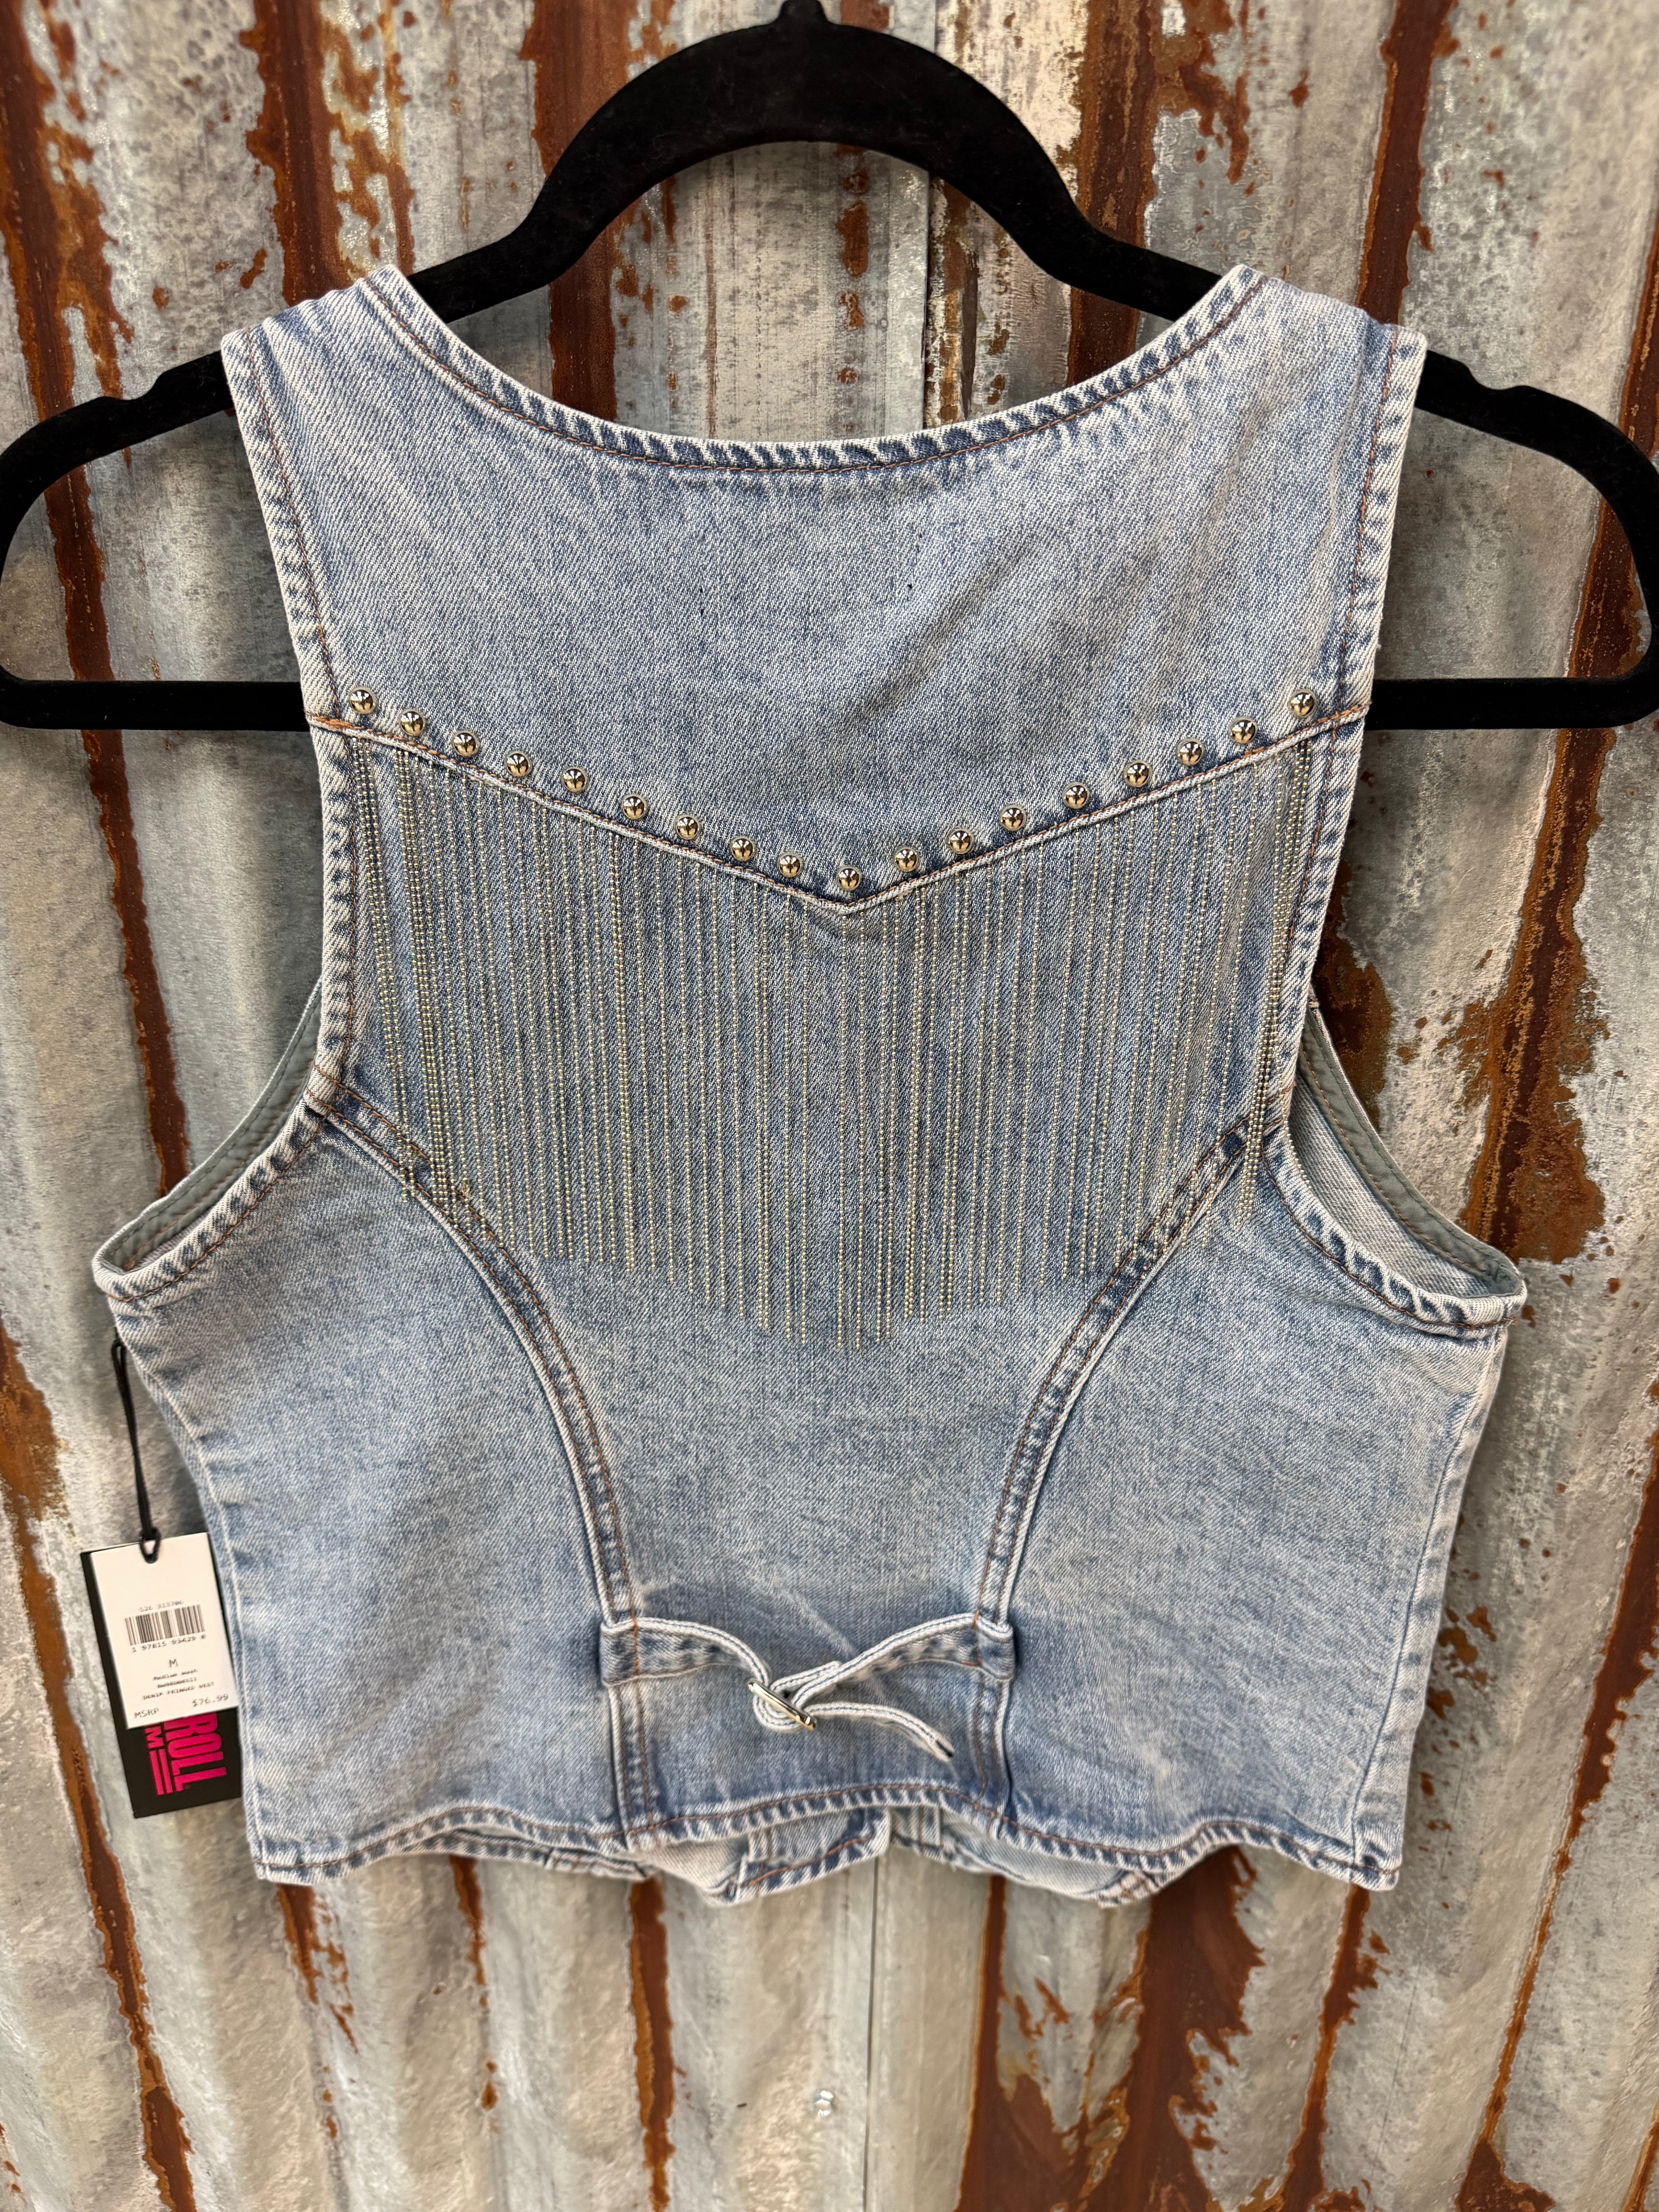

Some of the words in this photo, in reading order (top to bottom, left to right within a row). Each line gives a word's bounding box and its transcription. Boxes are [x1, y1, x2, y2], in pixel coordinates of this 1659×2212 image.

[169, 1659, 178, 1667] M
[192, 1694, 229, 1707] $76.99
[134, 1707, 159, 1718] MSRP
[164, 1713, 227, 1792] ROLL
